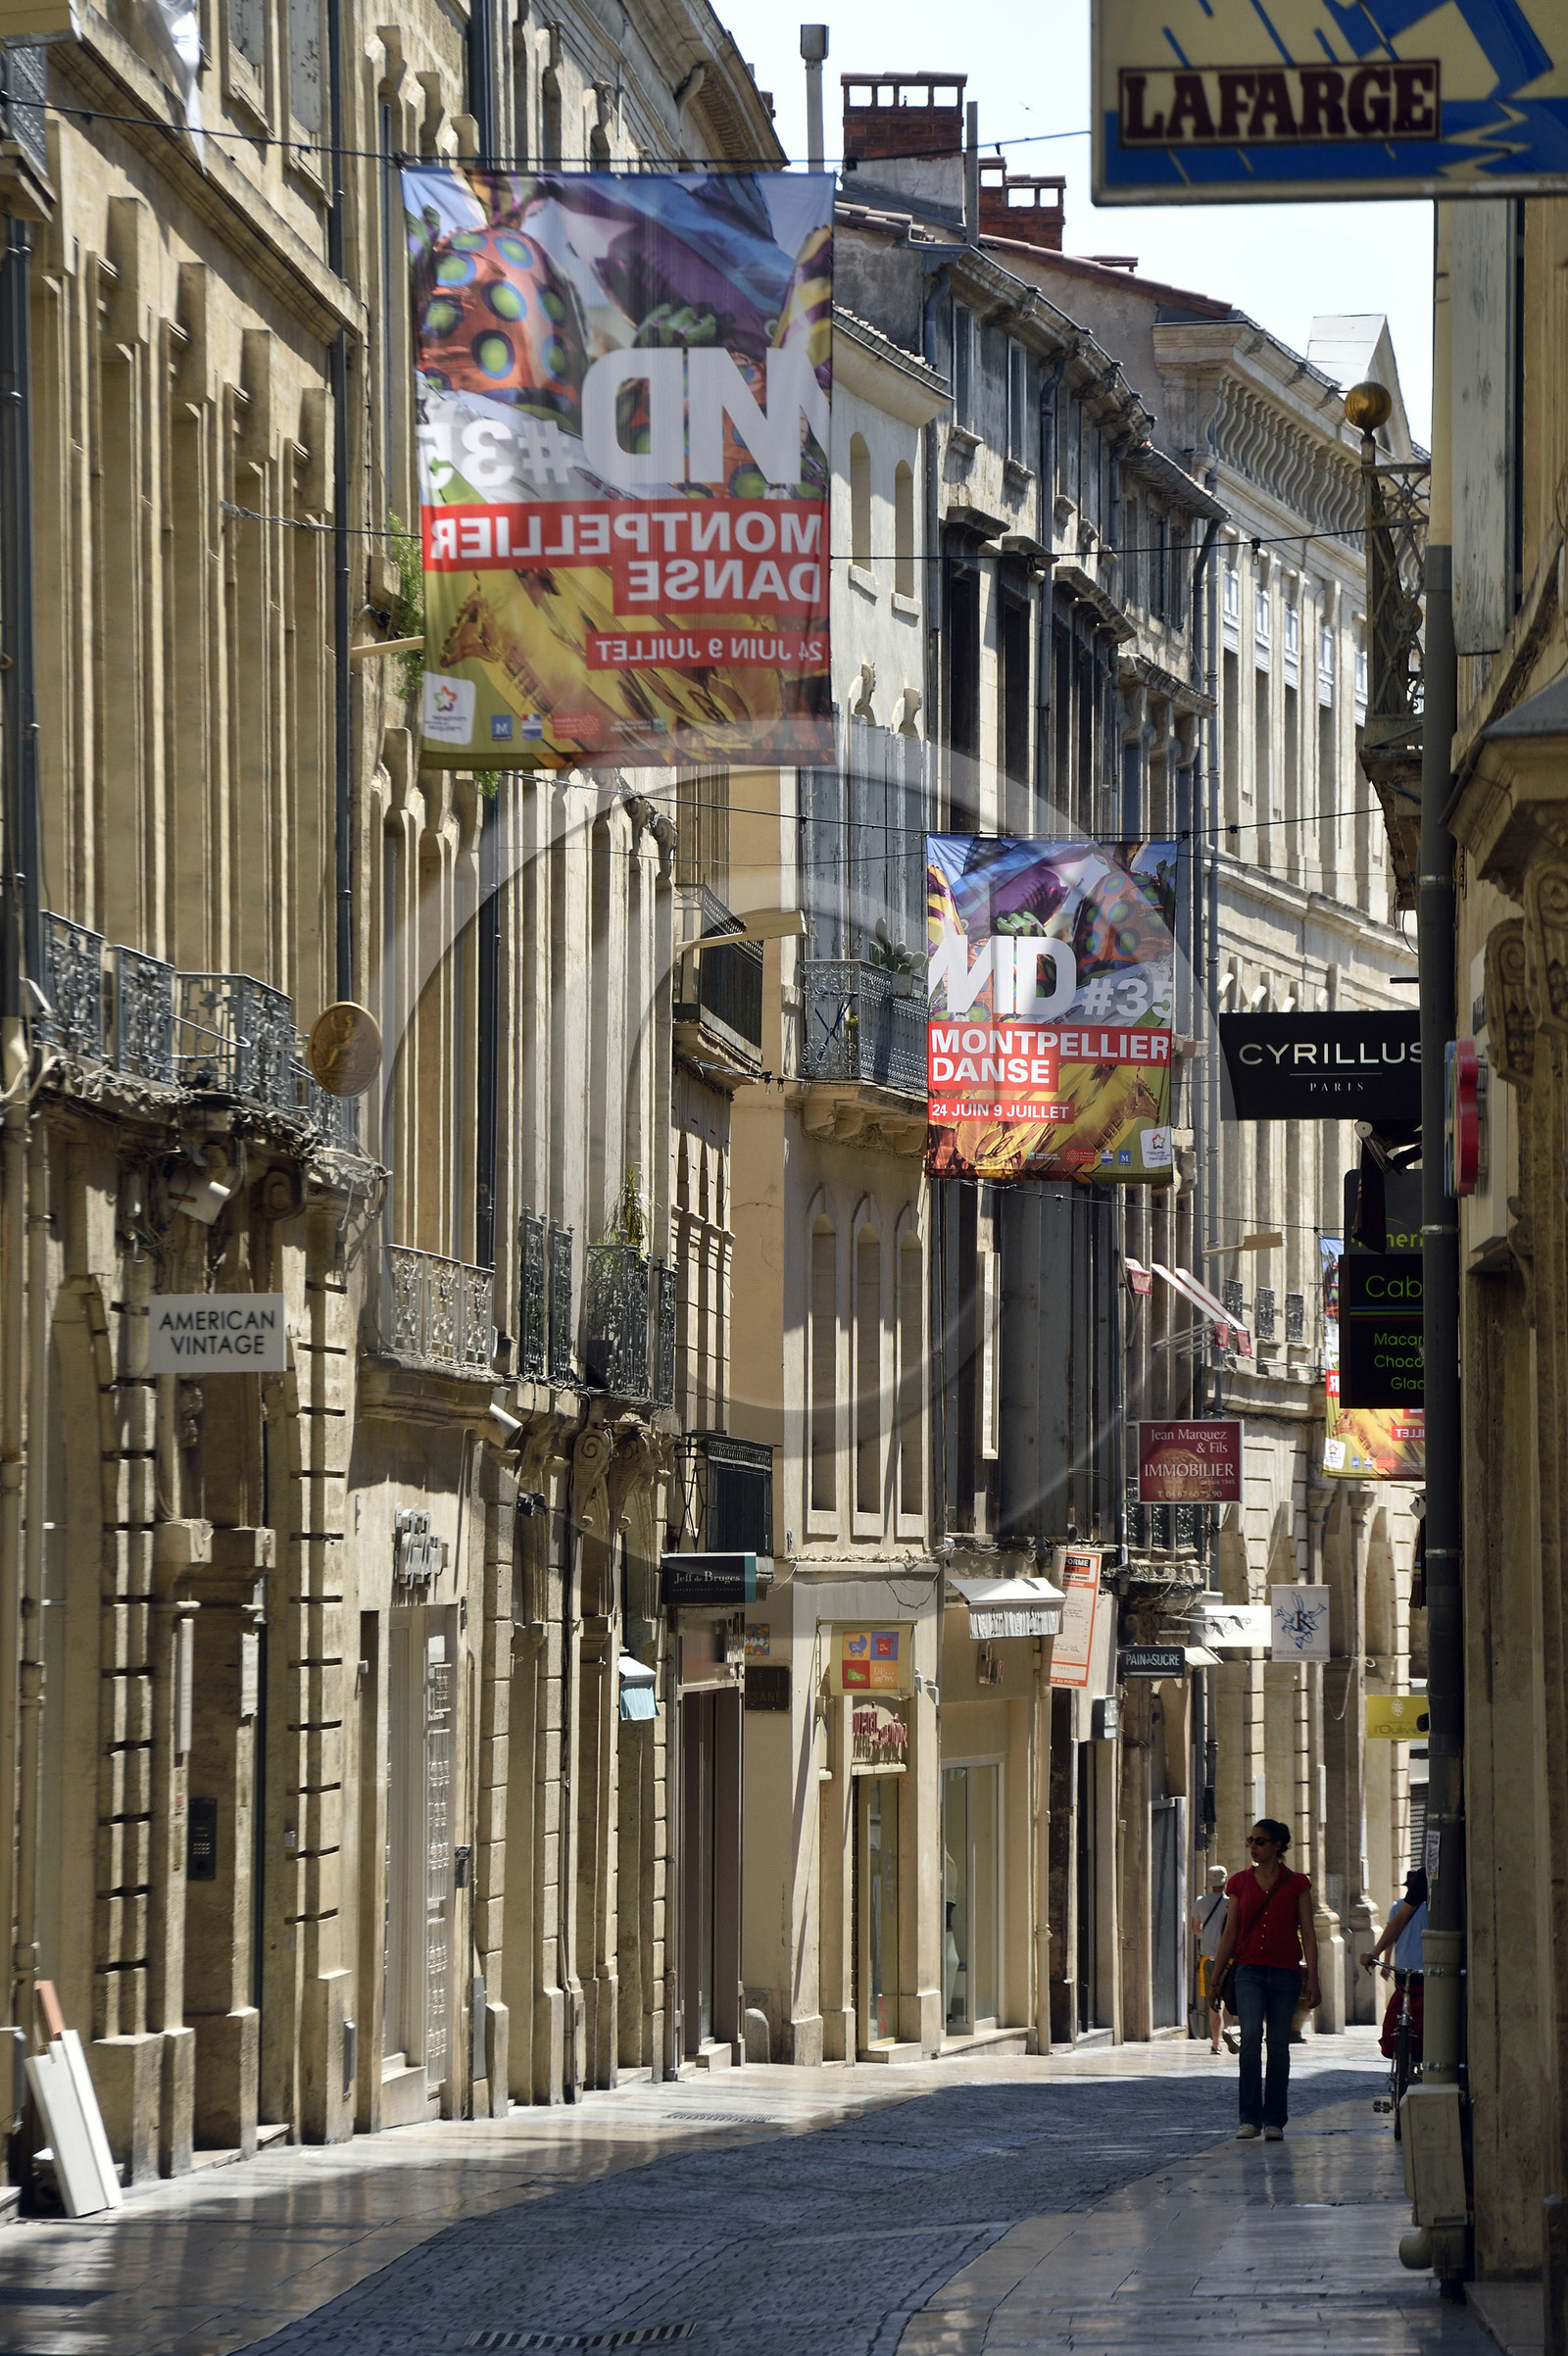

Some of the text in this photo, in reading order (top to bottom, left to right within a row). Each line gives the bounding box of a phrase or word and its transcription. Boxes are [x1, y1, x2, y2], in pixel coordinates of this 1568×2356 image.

[1126, 69, 1435, 139] LAFARGE
[931, 1029, 1169, 1060] MONTPELLIER
[1239, 1042, 1421, 1065] CYRILLUS
[932, 1056, 1050, 1084] DANSE
[1309, 1082, 1364, 1092] PARIS
[932, 1104, 1069, 1119] 24 JUIN 9 JUILLET
[159, 1310, 274, 1331] AMERICAN
[171, 1335, 265, 1354] VINTAGE
[1151, 1429, 1227, 1442] Jean Marquez
[1196, 1442, 1228, 1453] & Fils
[1145, 1463, 1235, 1477] IMMOBILIER
[674, 1572, 694, 1584] Jeff
[704, 1570, 741, 1584] Bruges
[1126, 1653, 1146, 1665] PAIN
[1152, 1653, 1180, 1666] SUCRE
